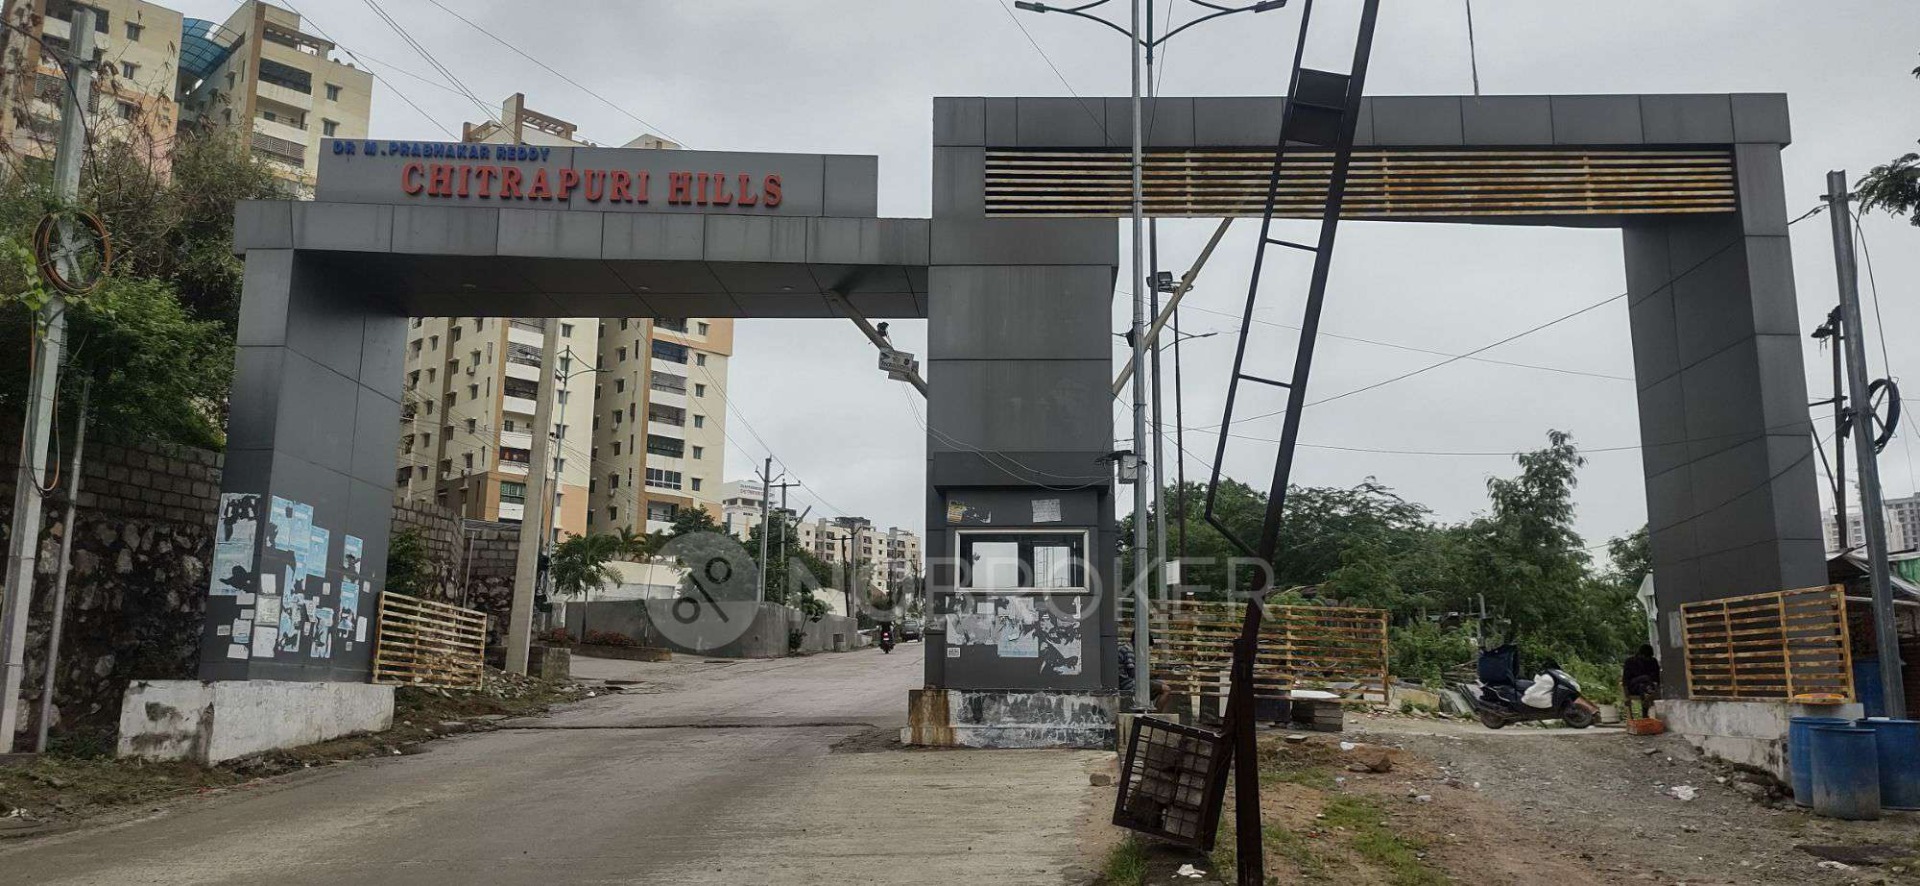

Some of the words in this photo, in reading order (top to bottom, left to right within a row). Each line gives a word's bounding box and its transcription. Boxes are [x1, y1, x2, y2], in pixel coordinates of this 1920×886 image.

[332, 141, 356, 156] DR
[495, 144, 550, 163] REDDY
[402, 162, 649, 204] CHITRAPURI
[667, 171, 783, 207] HILLS
